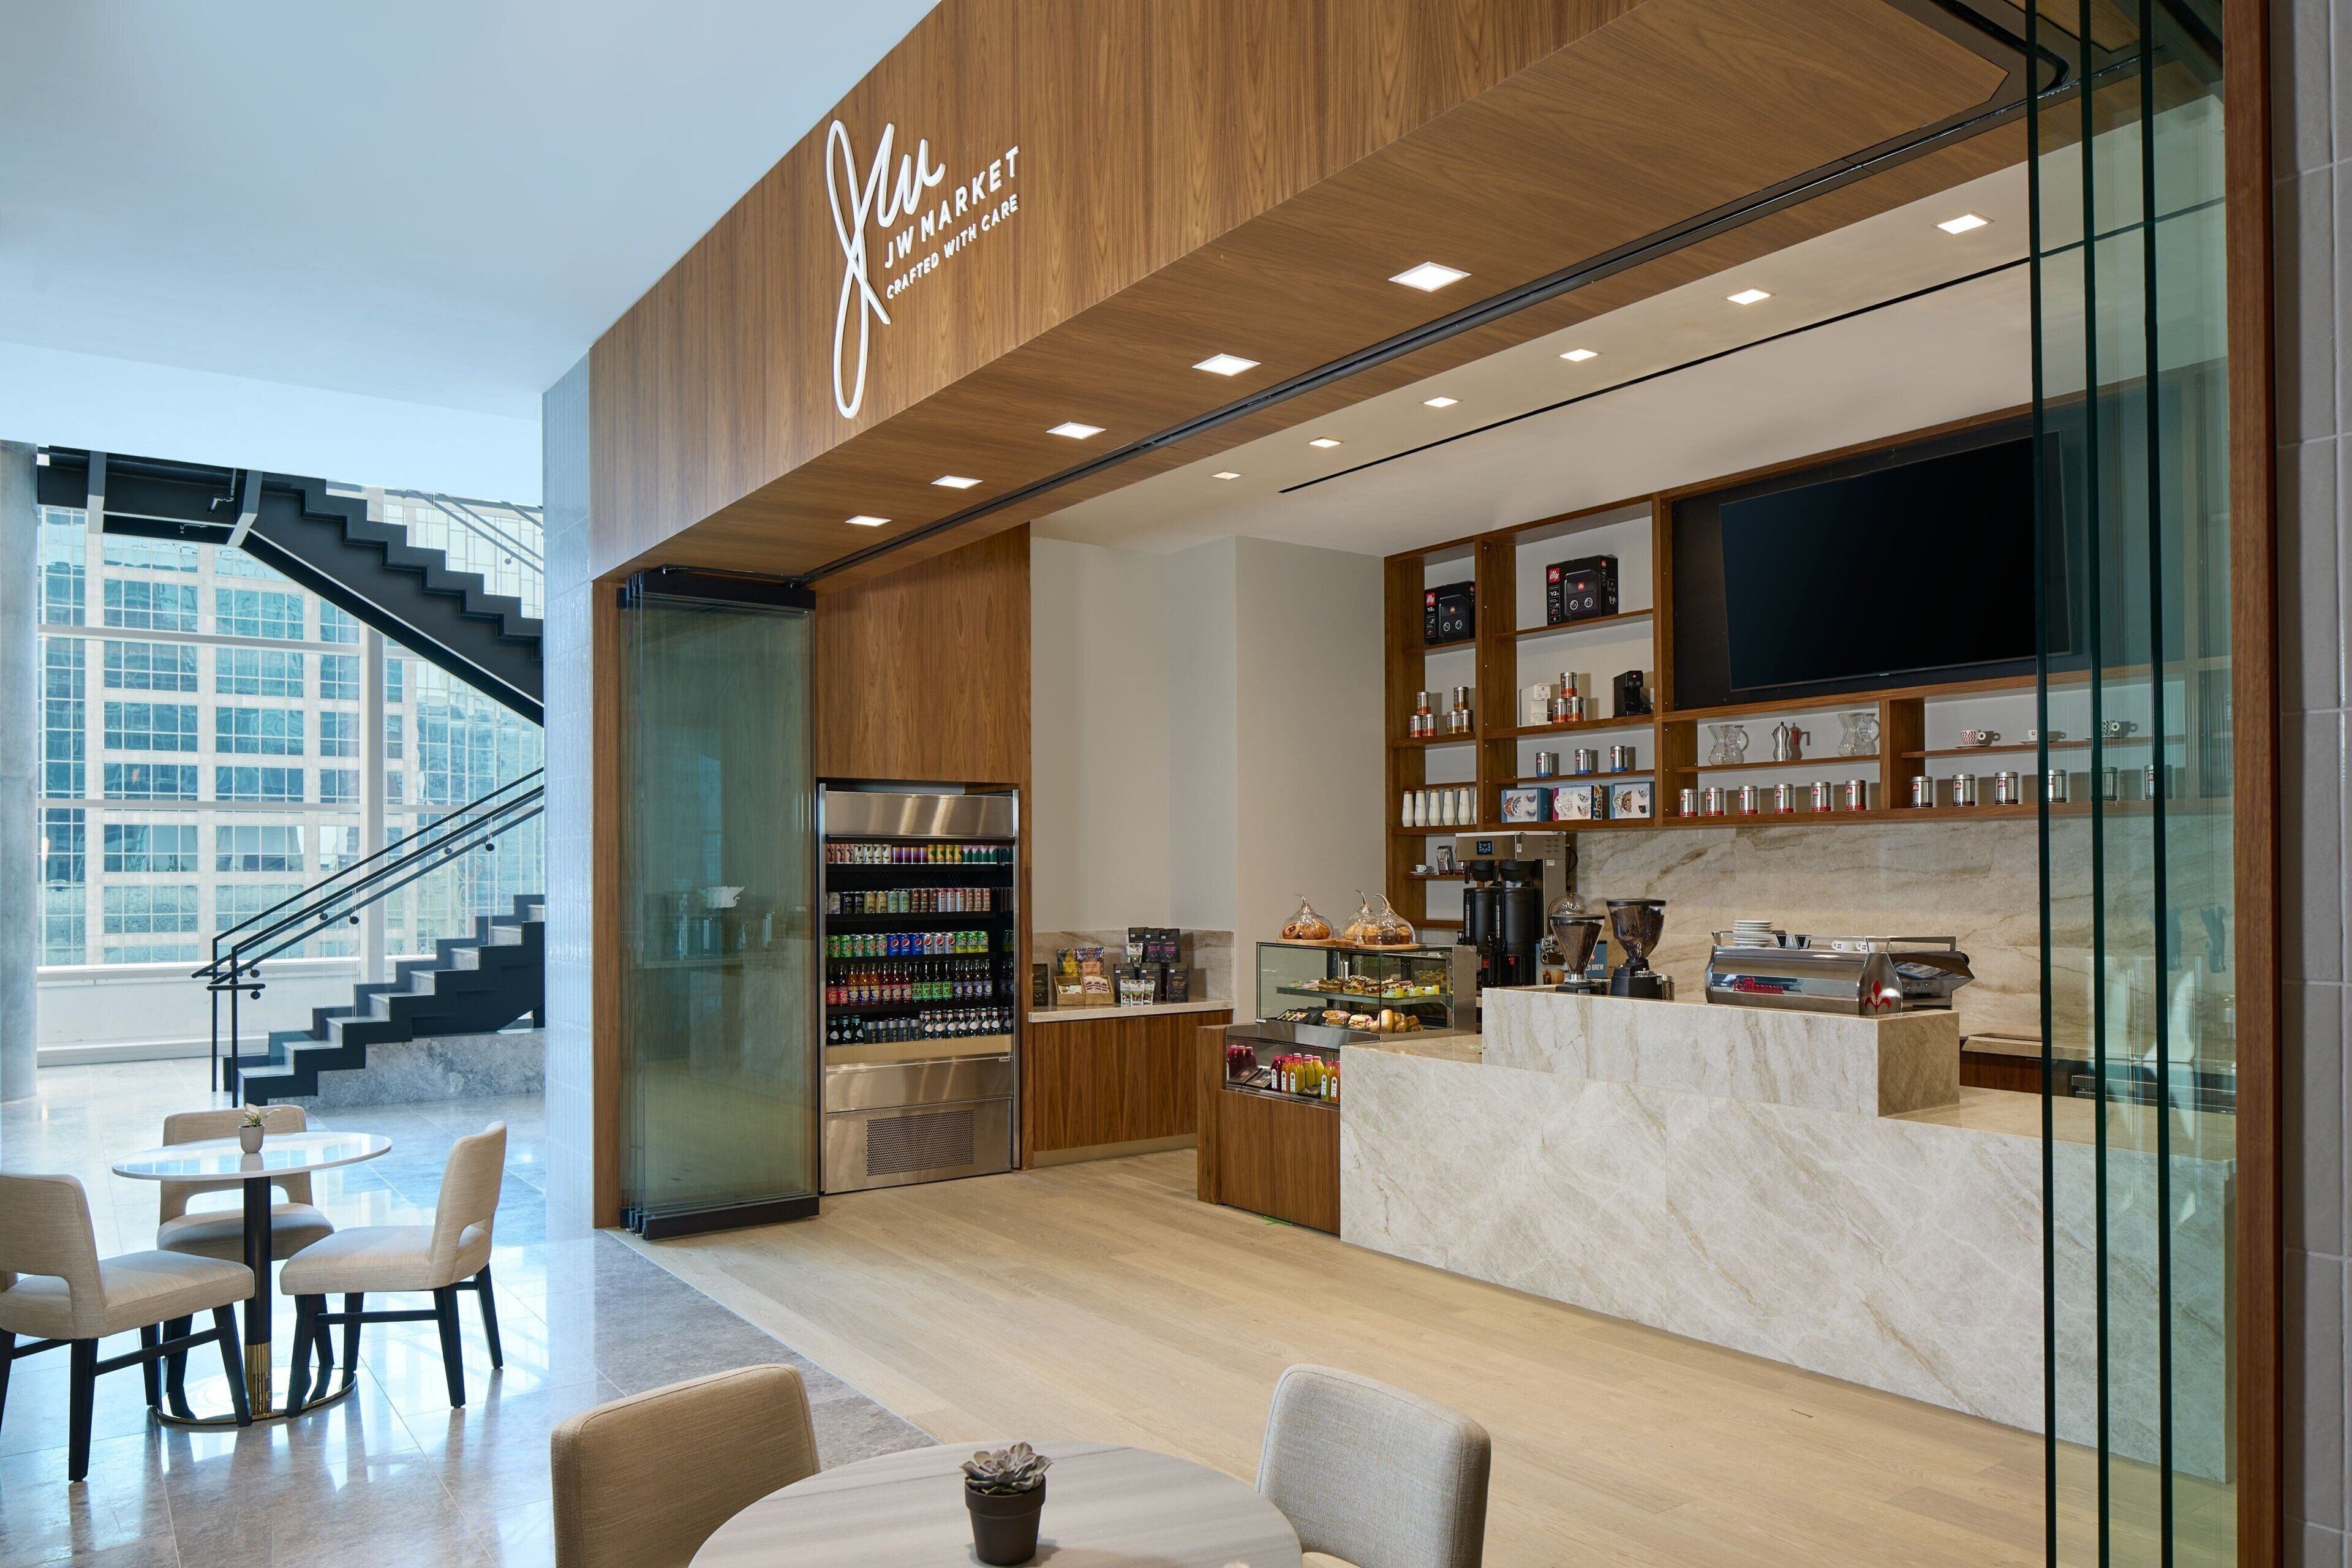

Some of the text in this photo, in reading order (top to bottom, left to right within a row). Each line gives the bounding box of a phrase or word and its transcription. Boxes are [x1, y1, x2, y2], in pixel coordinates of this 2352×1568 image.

[884, 145, 1020, 269] JW MARKET
[886, 194, 1019, 300] CRAFTED WITH CARE
[1427, 595, 1435, 604] illy
[1549, 571, 1559, 581] illy
